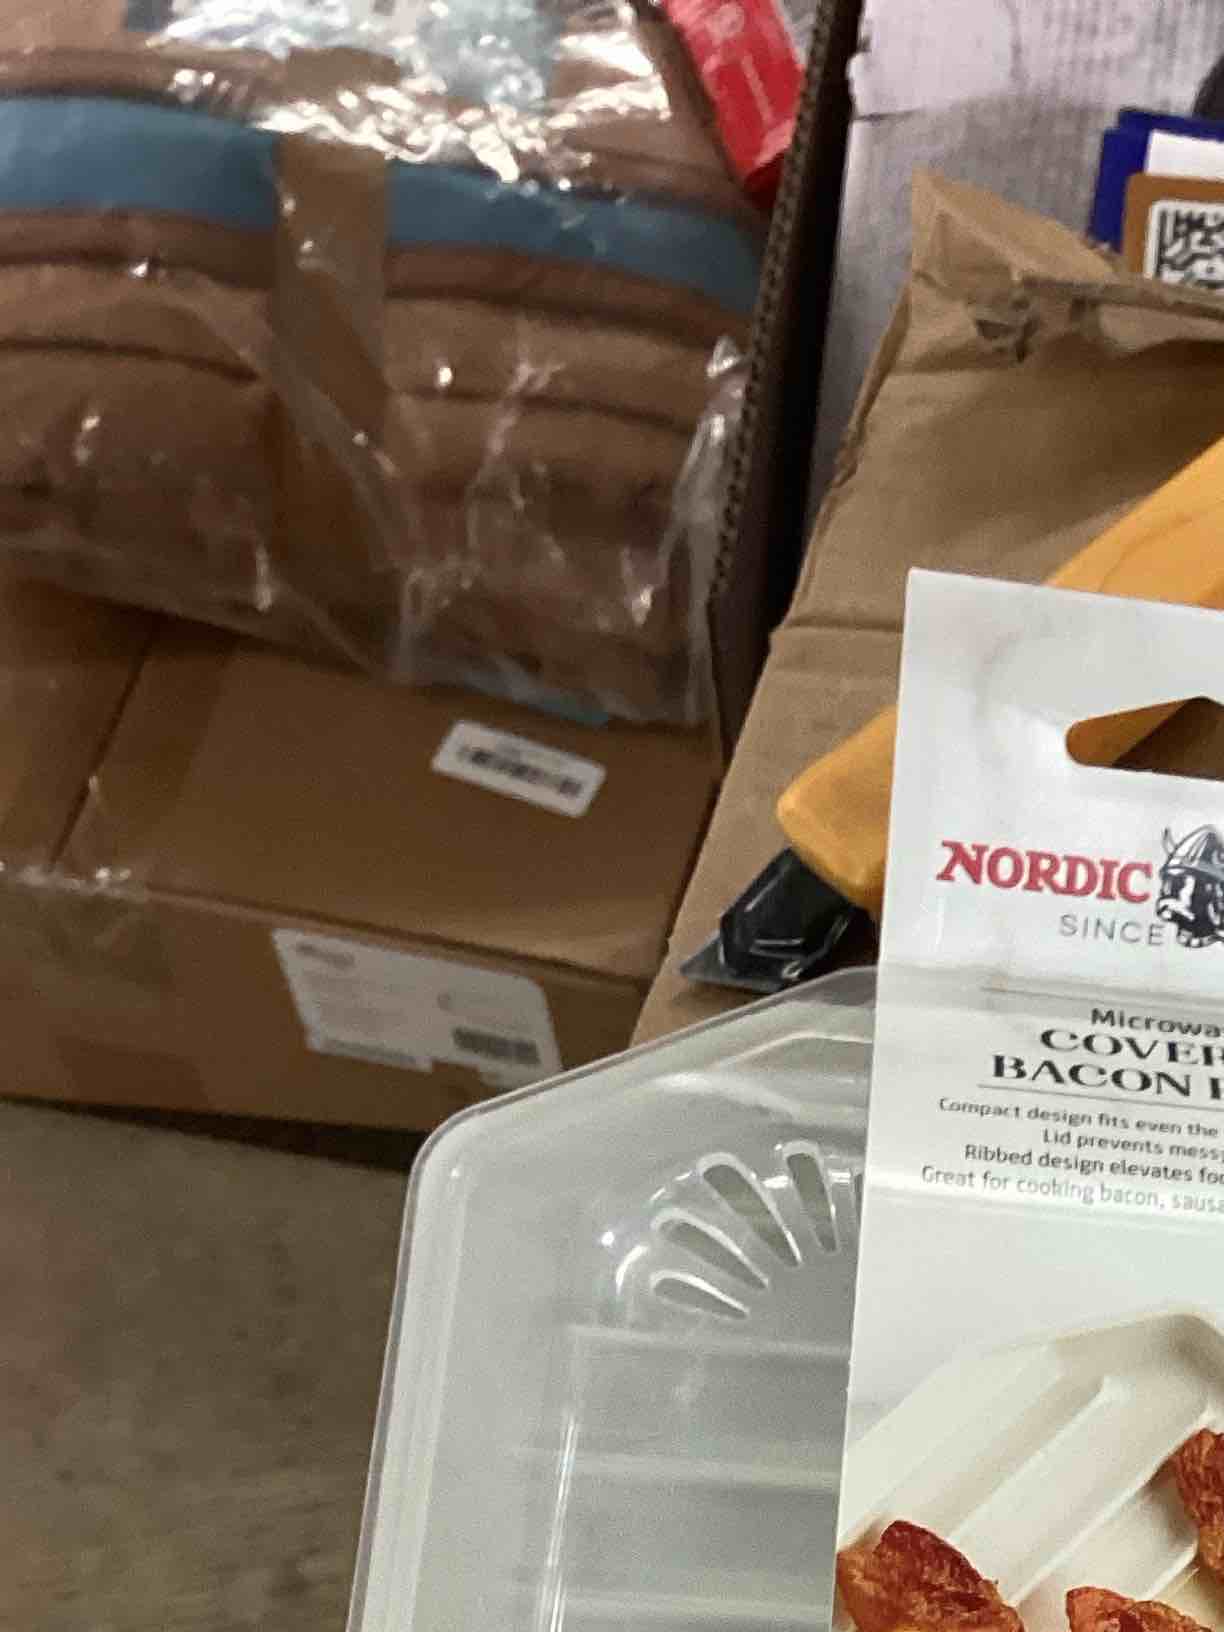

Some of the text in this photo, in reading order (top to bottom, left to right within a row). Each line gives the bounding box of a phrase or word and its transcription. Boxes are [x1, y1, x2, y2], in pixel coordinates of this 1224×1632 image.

[936, 839, 1153, 904] NORDIC
[1059, 913, 1166, 946] SINCE
[992, 1055, 1192, 1097] BACON
[939, 1097, 1021, 1118] Compact
[1027, 1106, 1092, 1127] design
[1098, 1112, 1130, 1130] fits
[1135, 1119, 1182, 1135] even
[1187, 1123, 1218, 1139] the
[1043, 1127, 1072, 1146] Lid
[1076, 1133, 1164, 1156] prevents
[965, 1143, 1033, 1167] Ribbed
[1037, 1151, 1105, 1176] design
[1109, 1159, 1193, 1183] elevates
[921, 1164, 975, 1189] Great
[982, 1169, 1009, 1191] for
[1015, 1175, 1096, 1206] cooking
[1100, 1182, 1167, 1210] bacon,
